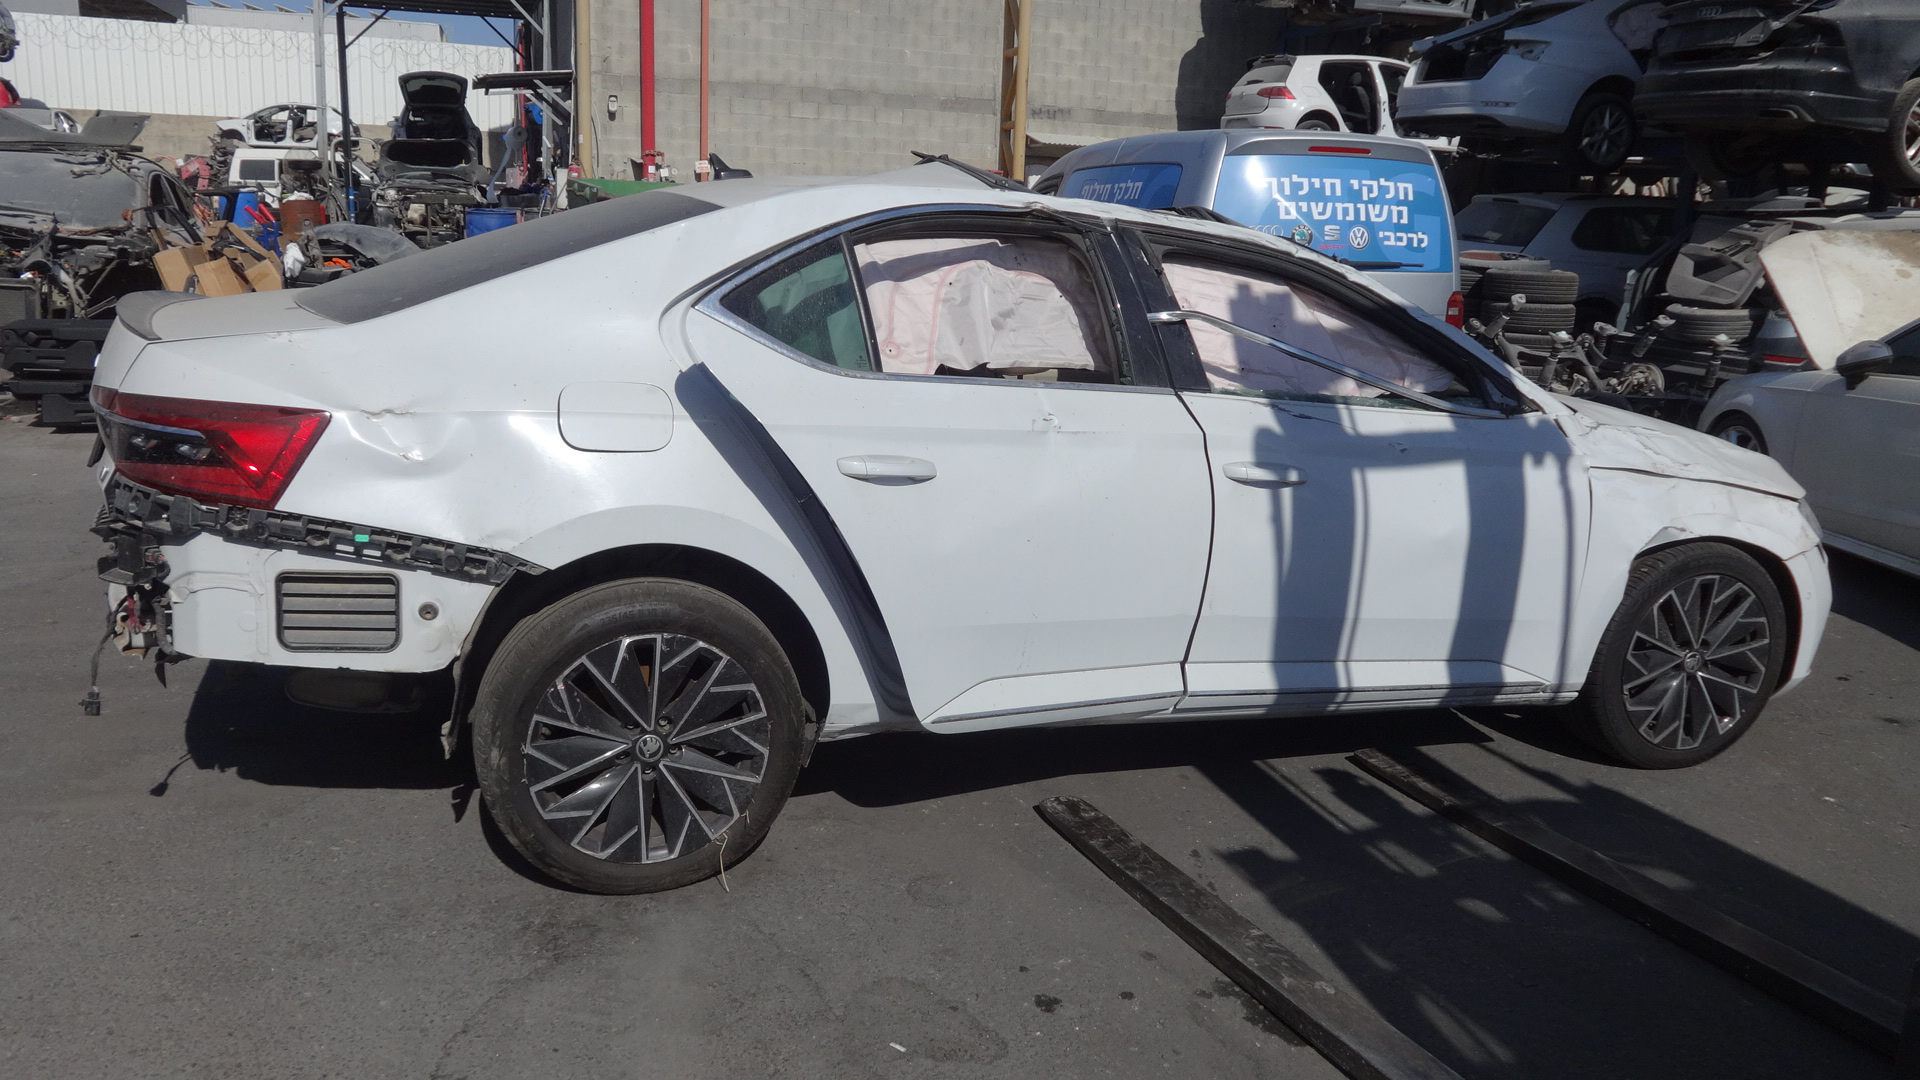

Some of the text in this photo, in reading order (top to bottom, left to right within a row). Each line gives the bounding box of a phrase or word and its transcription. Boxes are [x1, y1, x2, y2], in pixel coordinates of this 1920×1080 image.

[1081, 179, 1143, 203] חלקי חילוף
[1350, 177, 1414, 201] חלקי
[1277, 201, 1409, 224] משומשים
[1378, 230, 1429, 248] לרכבי
